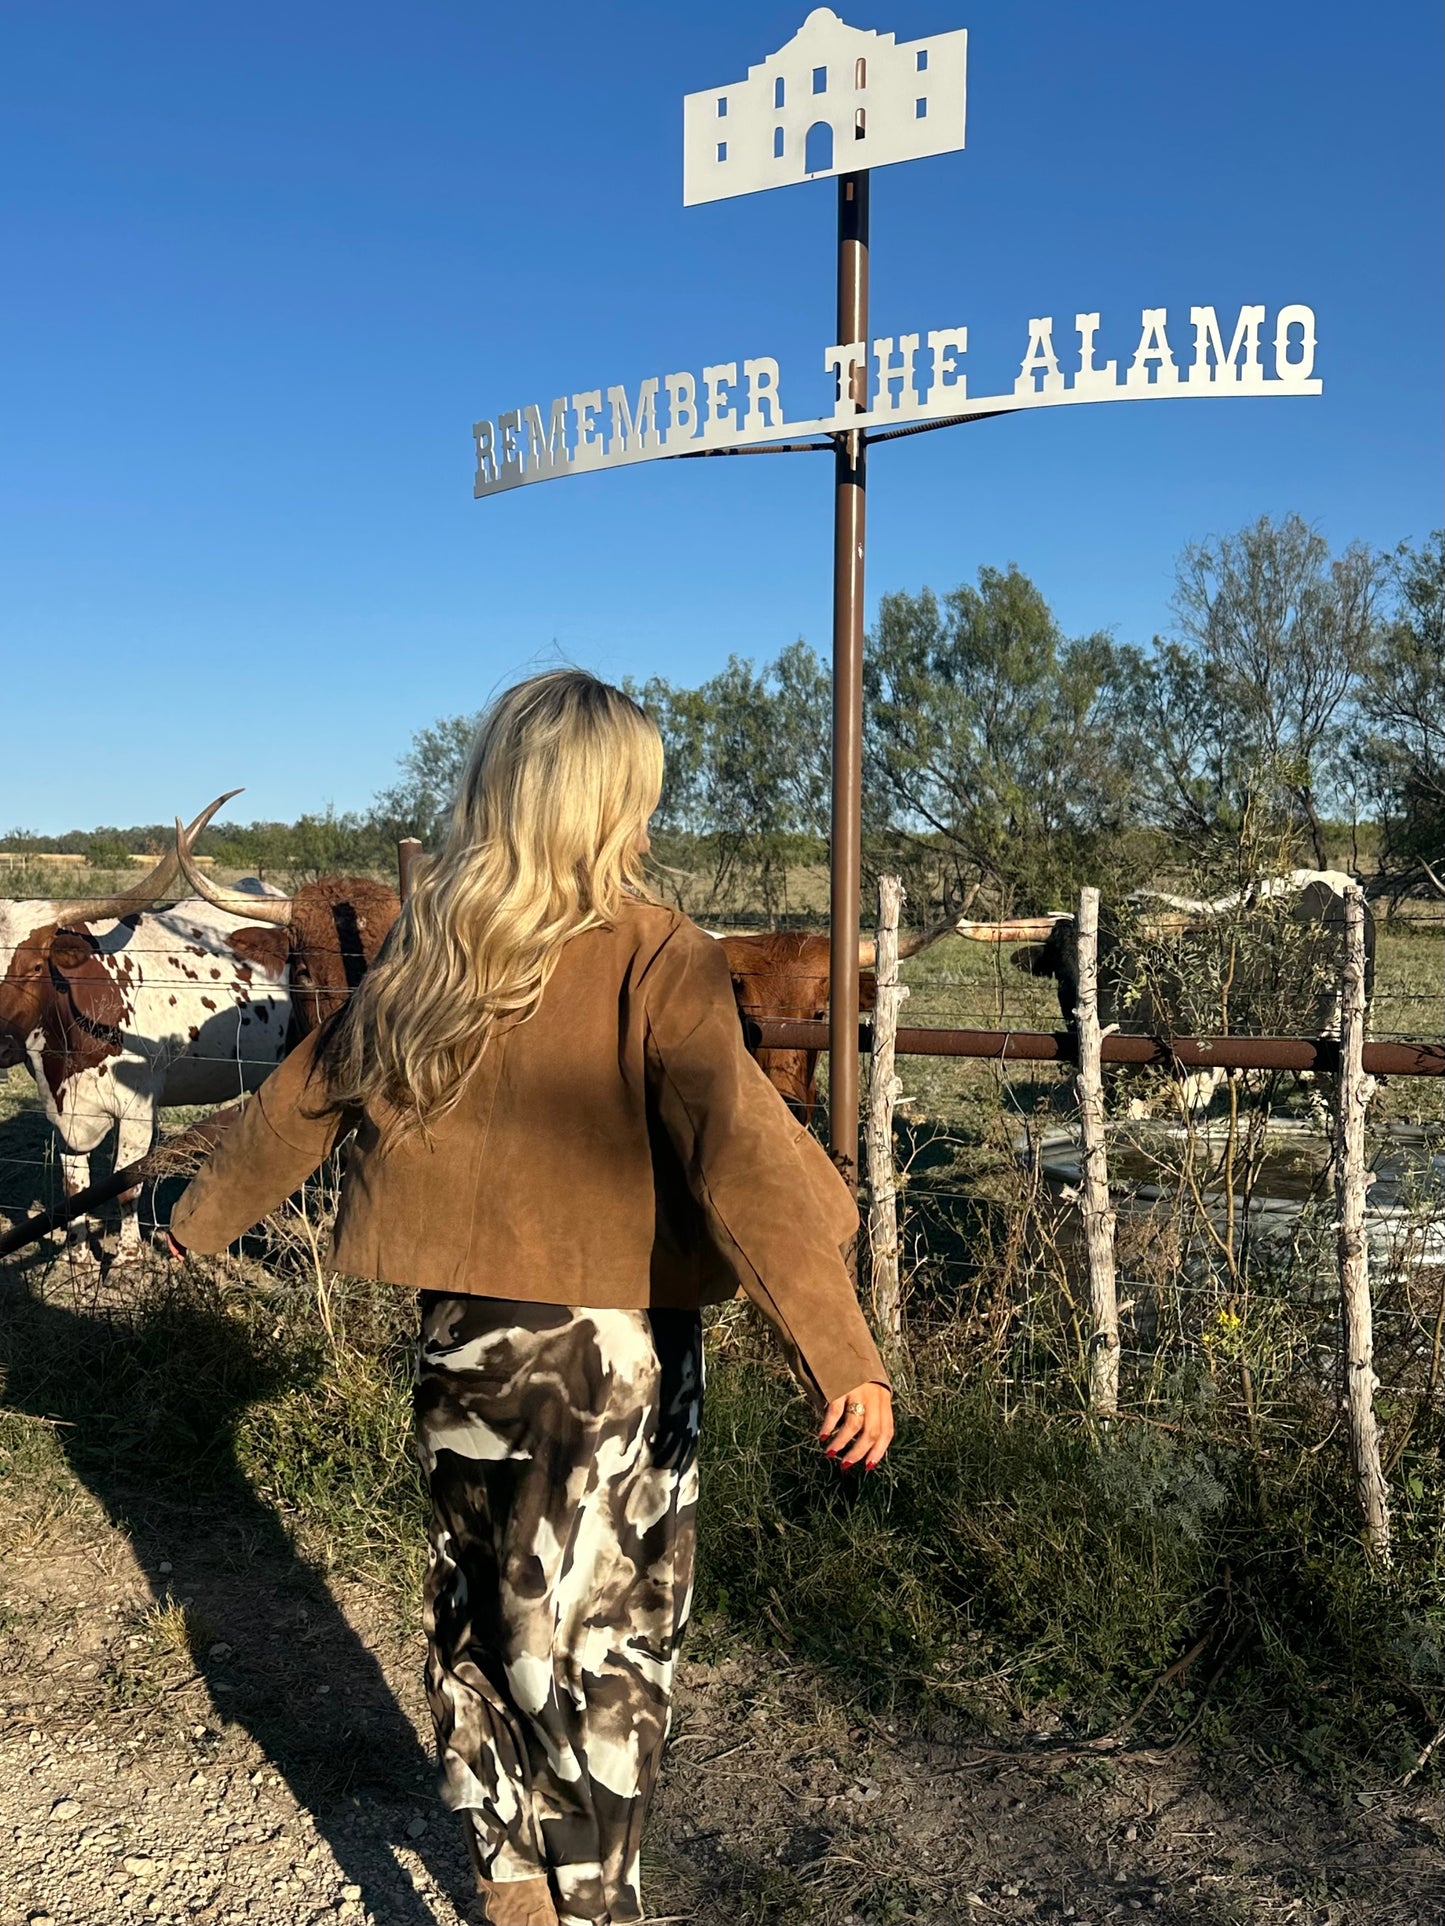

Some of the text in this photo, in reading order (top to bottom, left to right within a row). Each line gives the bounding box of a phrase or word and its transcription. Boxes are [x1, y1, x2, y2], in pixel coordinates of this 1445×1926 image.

[472, 304, 1316, 484] REMEMBER THE ALAMO
